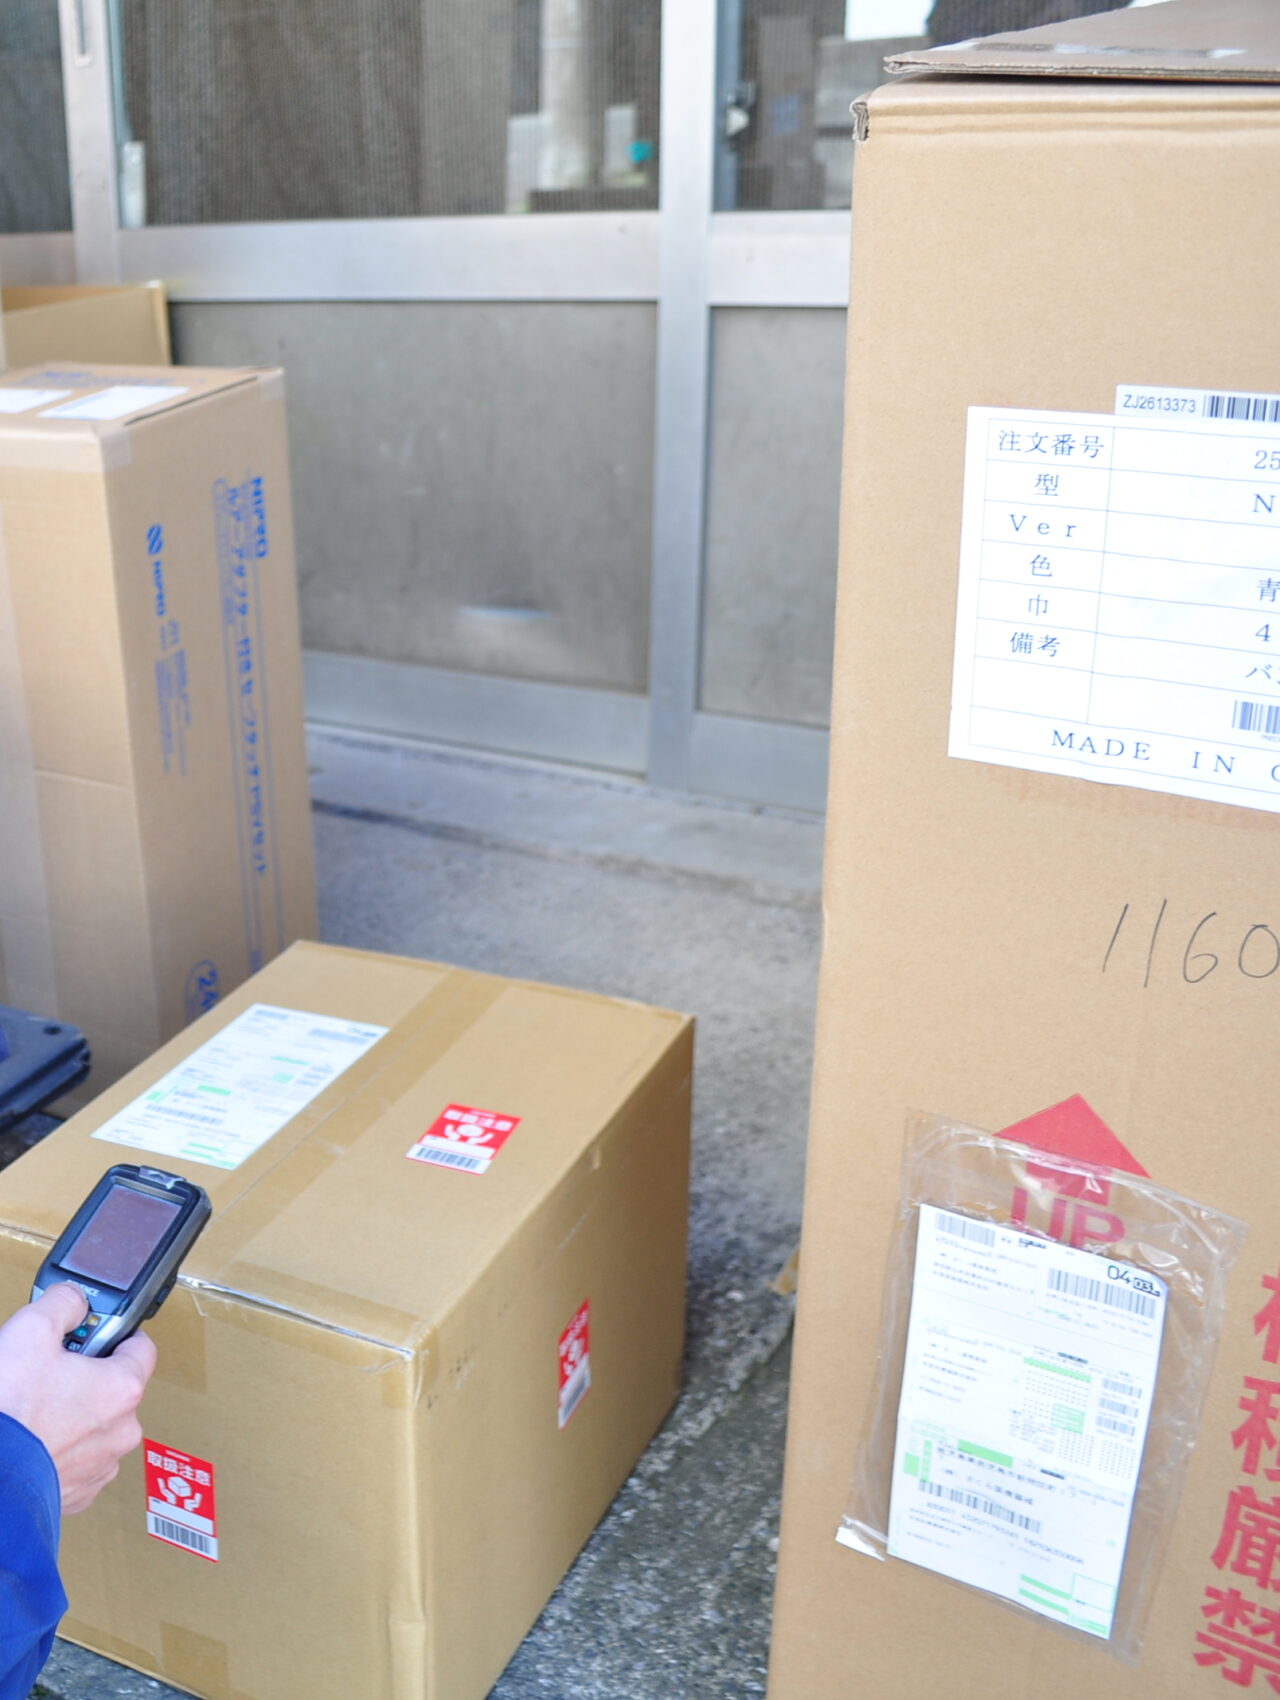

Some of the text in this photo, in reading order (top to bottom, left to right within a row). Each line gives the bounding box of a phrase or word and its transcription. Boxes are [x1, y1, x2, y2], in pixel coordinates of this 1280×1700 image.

[1122, 394, 1198, 413] ZJ2613373
[998, 429, 1105, 459] 注文番号
[1033, 472, 1060, 498] 型
[1029, 553, 1054, 578] 色
[1027, 594, 1050, 617] 巾
[1009, 631, 1061, 659] 備考
[1051, 729, 1152, 762] MADE
[1191, 751, 1236, 776] IN
[1101, 897, 1280, 989] 1160
[1011, 1186, 1126, 1249] UP
[146, 1449, 211, 1488] 取扱注意
